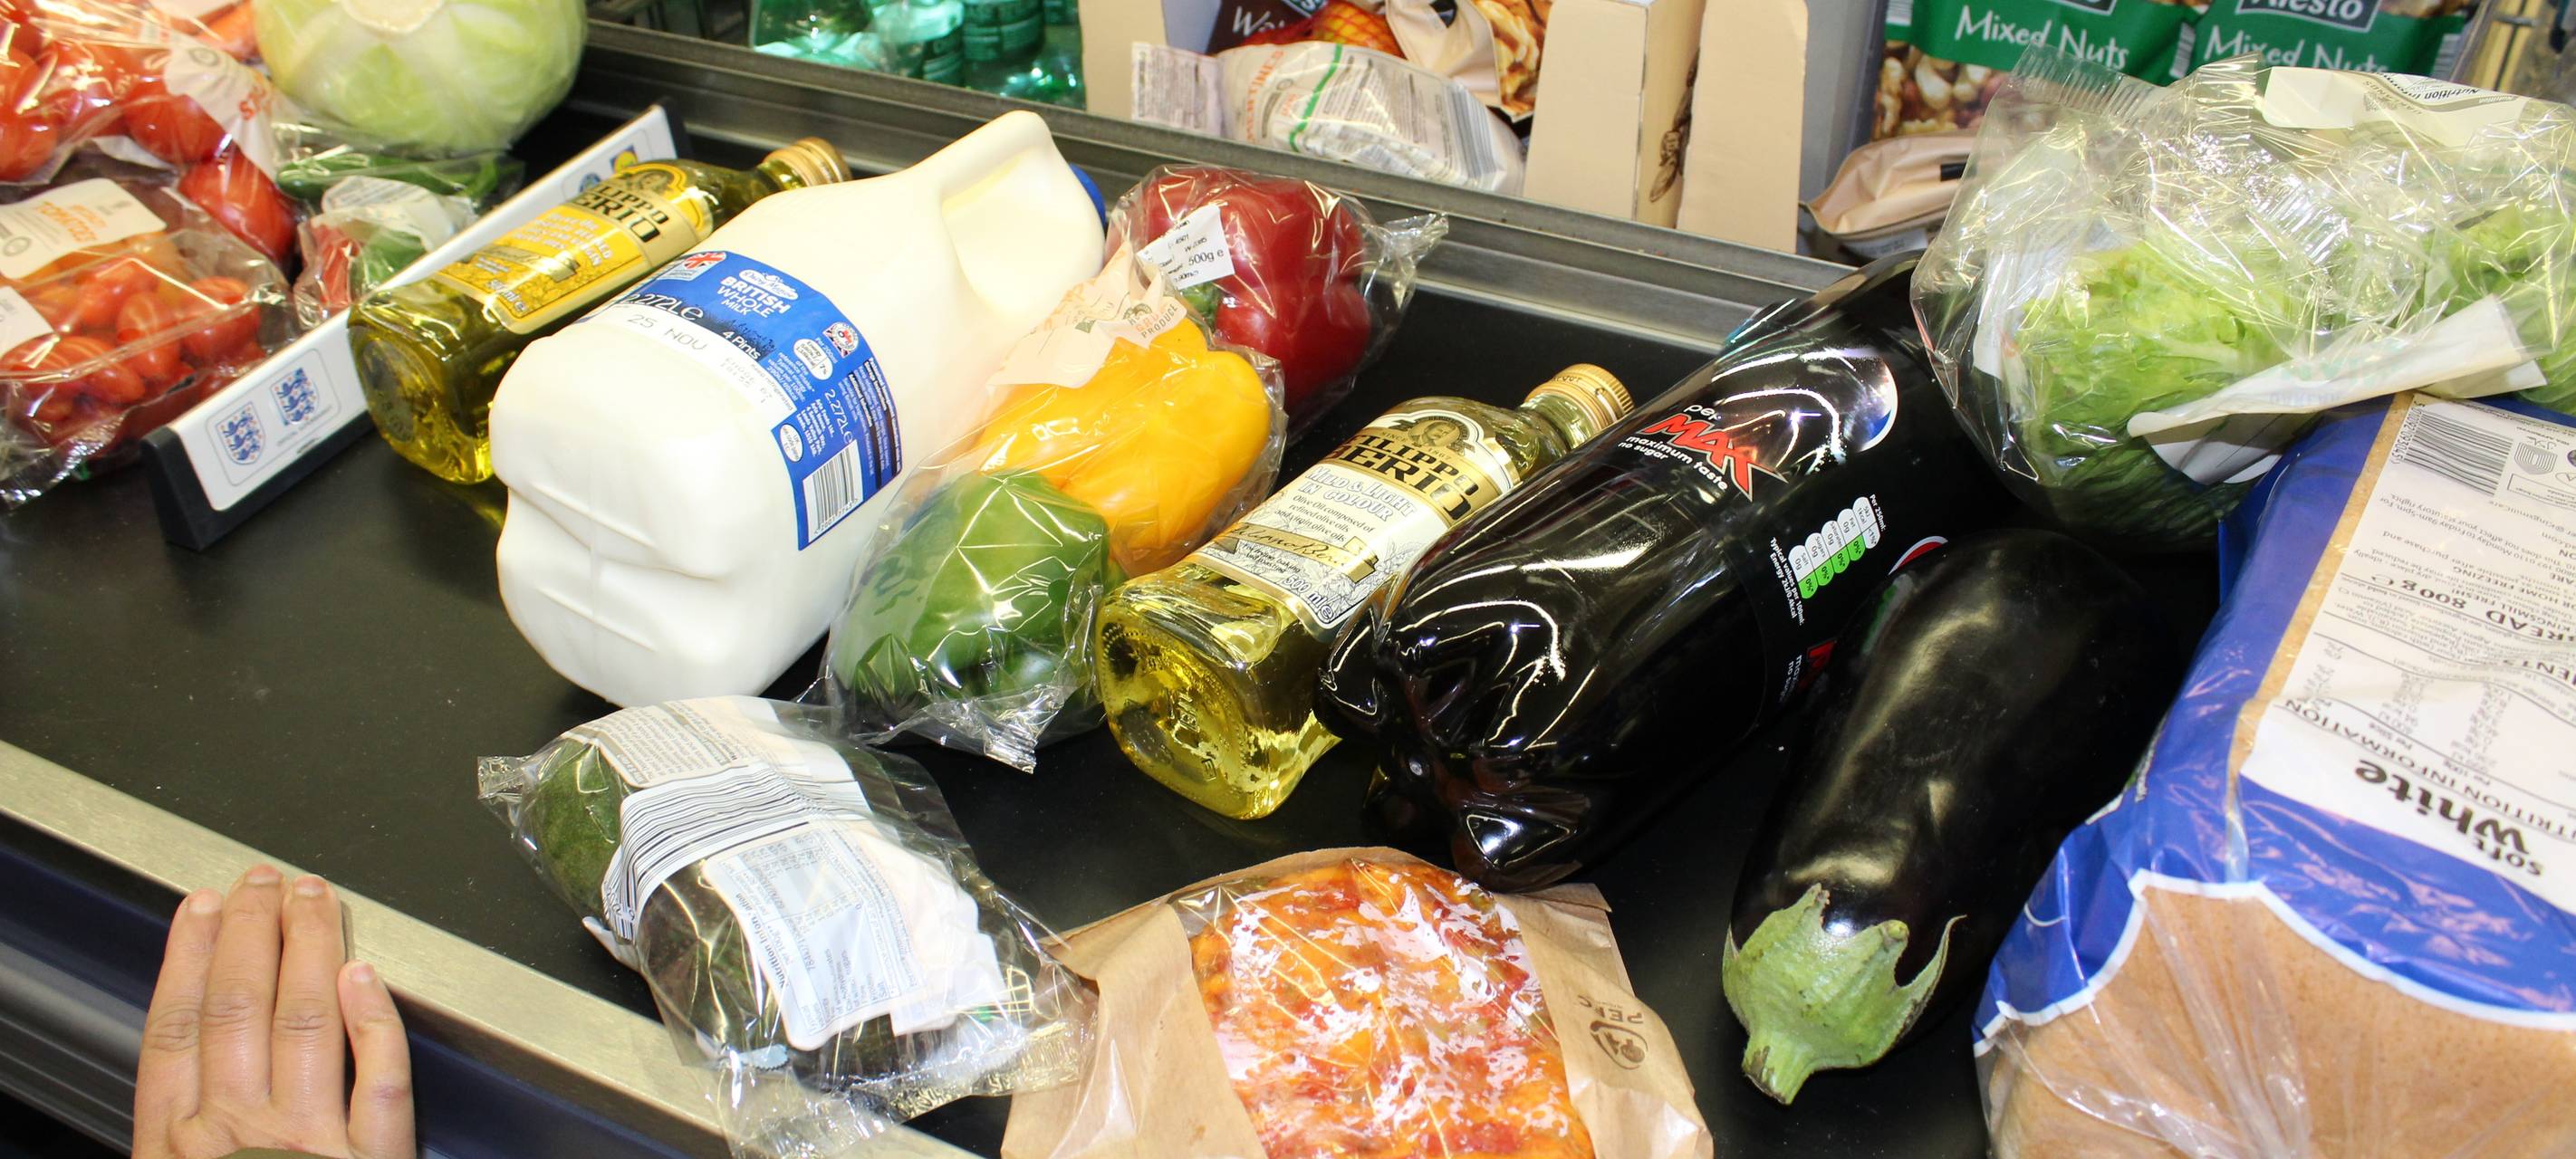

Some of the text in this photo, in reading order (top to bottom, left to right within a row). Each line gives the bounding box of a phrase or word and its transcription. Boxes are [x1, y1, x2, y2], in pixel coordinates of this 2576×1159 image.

[2250, 0, 2363, 20] esto
[1954, 12, 2129, 71] Mixed Nuts
[2204, 24, 2304, 67] Mixed
[2424, 88, 2475, 101] Nutrition
[1188, 249, 1224, 265] 500g e
[717, 285, 774, 318] WHOLE
[720, 276, 792, 313] BRITISH
[721, 298, 752, 316] MILK
[628, 314, 658, 328] 25
[1141, 304, 1178, 339] PRODUCE
[723, 330, 761, 360] 4 Pints
[1618, 441, 1668, 462] no sugar
[1625, 435, 1728, 492] maximum taste
[1639, 413, 1789, 502] MAX
[1299, 480, 1399, 522] IN COLOUR
[1305, 466, 1418, 519] MILD & LIGHT
[1274, 507, 1347, 543] and virgin olive oils
[1288, 502, 1350, 533] refined olive oils
[1293, 493, 1375, 534] Olive Oil composed of
[1841, 521, 1851, 532] 0g
[1869, 494, 1887, 532] Per 250ml:
[2456, 518, 2478, 532] your
[1810, 545, 1820, 557] 0g
[1814, 536, 1827, 558] Sugars
[1825, 532, 1835, 545] 0g
[2403, 537, 2449, 560] purchase
[2476, 534, 2513, 556] Monday
[2477, 527, 2504, 543] affect
[1793, 557, 1803, 570] 0g
[1283, 576, 1334, 620] 500 ml e
[1769, 537, 1805, 627] Typical values per 100ml:
[1769, 551, 1797, 619] Energy 2kJ/0.4kcal
[2451, 565, 2559, 605] HOME FREEZING
[2399, 578, 2575, 641] READ 800g
[2497, 600, 2571, 633] KINGSMILL
[2283, 697, 2456, 789] INFORMATION
[2355, 758, 2529, 855] white
[2472, 838, 2542, 876] soft
[762, 943, 788, 988] Nutrition
